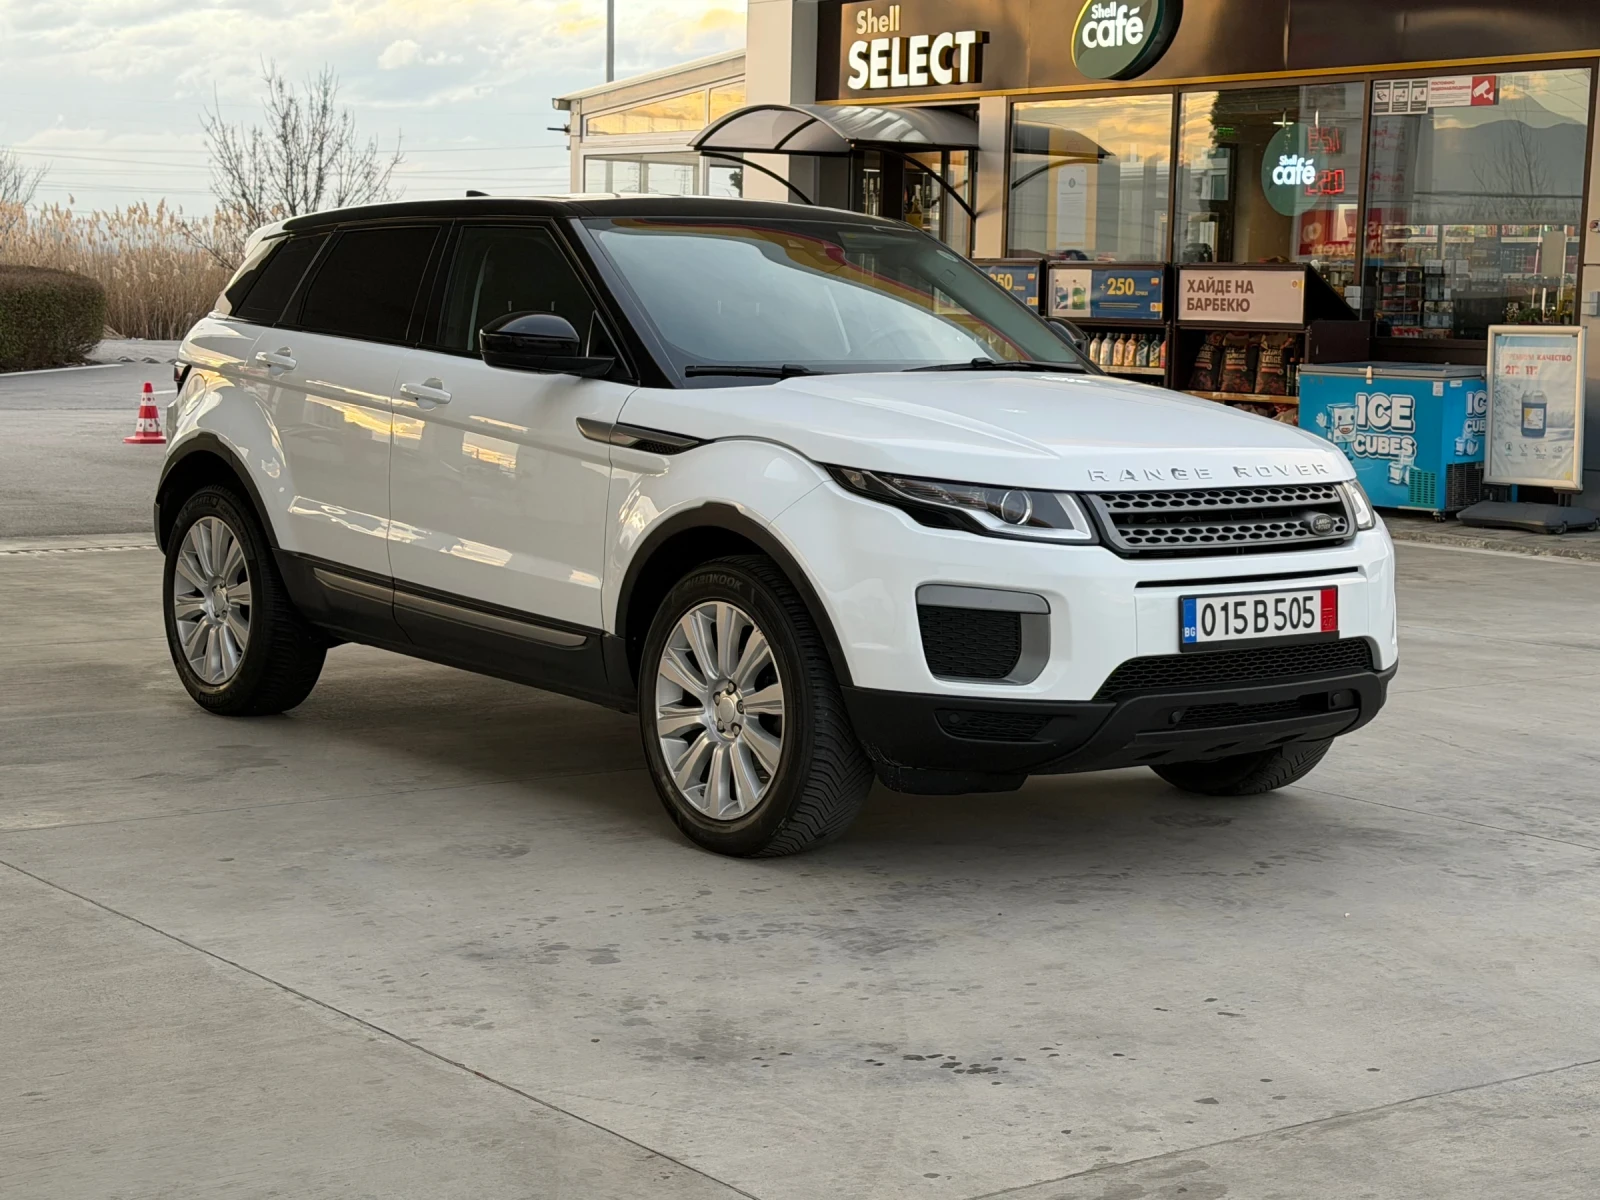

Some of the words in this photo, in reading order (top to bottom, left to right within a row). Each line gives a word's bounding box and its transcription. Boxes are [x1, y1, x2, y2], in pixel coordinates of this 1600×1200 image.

[856, 4, 900, 34] Shell
[1091, 1, 1117, 19] Shell
[1082, 4, 1144, 49] café
[847, 30, 977, 90] SELECT
[1272, 157, 1316, 185] café
[1186, 276, 1232, 296] ХАЙДЕ
[1235, 280, 1255, 294] НА
[1186, 297, 1251, 313] БАРБЕКЮ
[1537, 354, 1573, 362] КАЧЕСТВО
[1357, 393, 1413, 430] ICE
[1467, 391, 1487, 415] IC
[1465, 420, 1486, 433] CUB
[1353, 434, 1415, 455] CUBES
[1087, 467, 1213, 482] RANGE
[1232, 463, 1329, 478] ROVER
[1184, 626, 1196, 638] BG
[1201, 595, 1315, 637] 015B505
